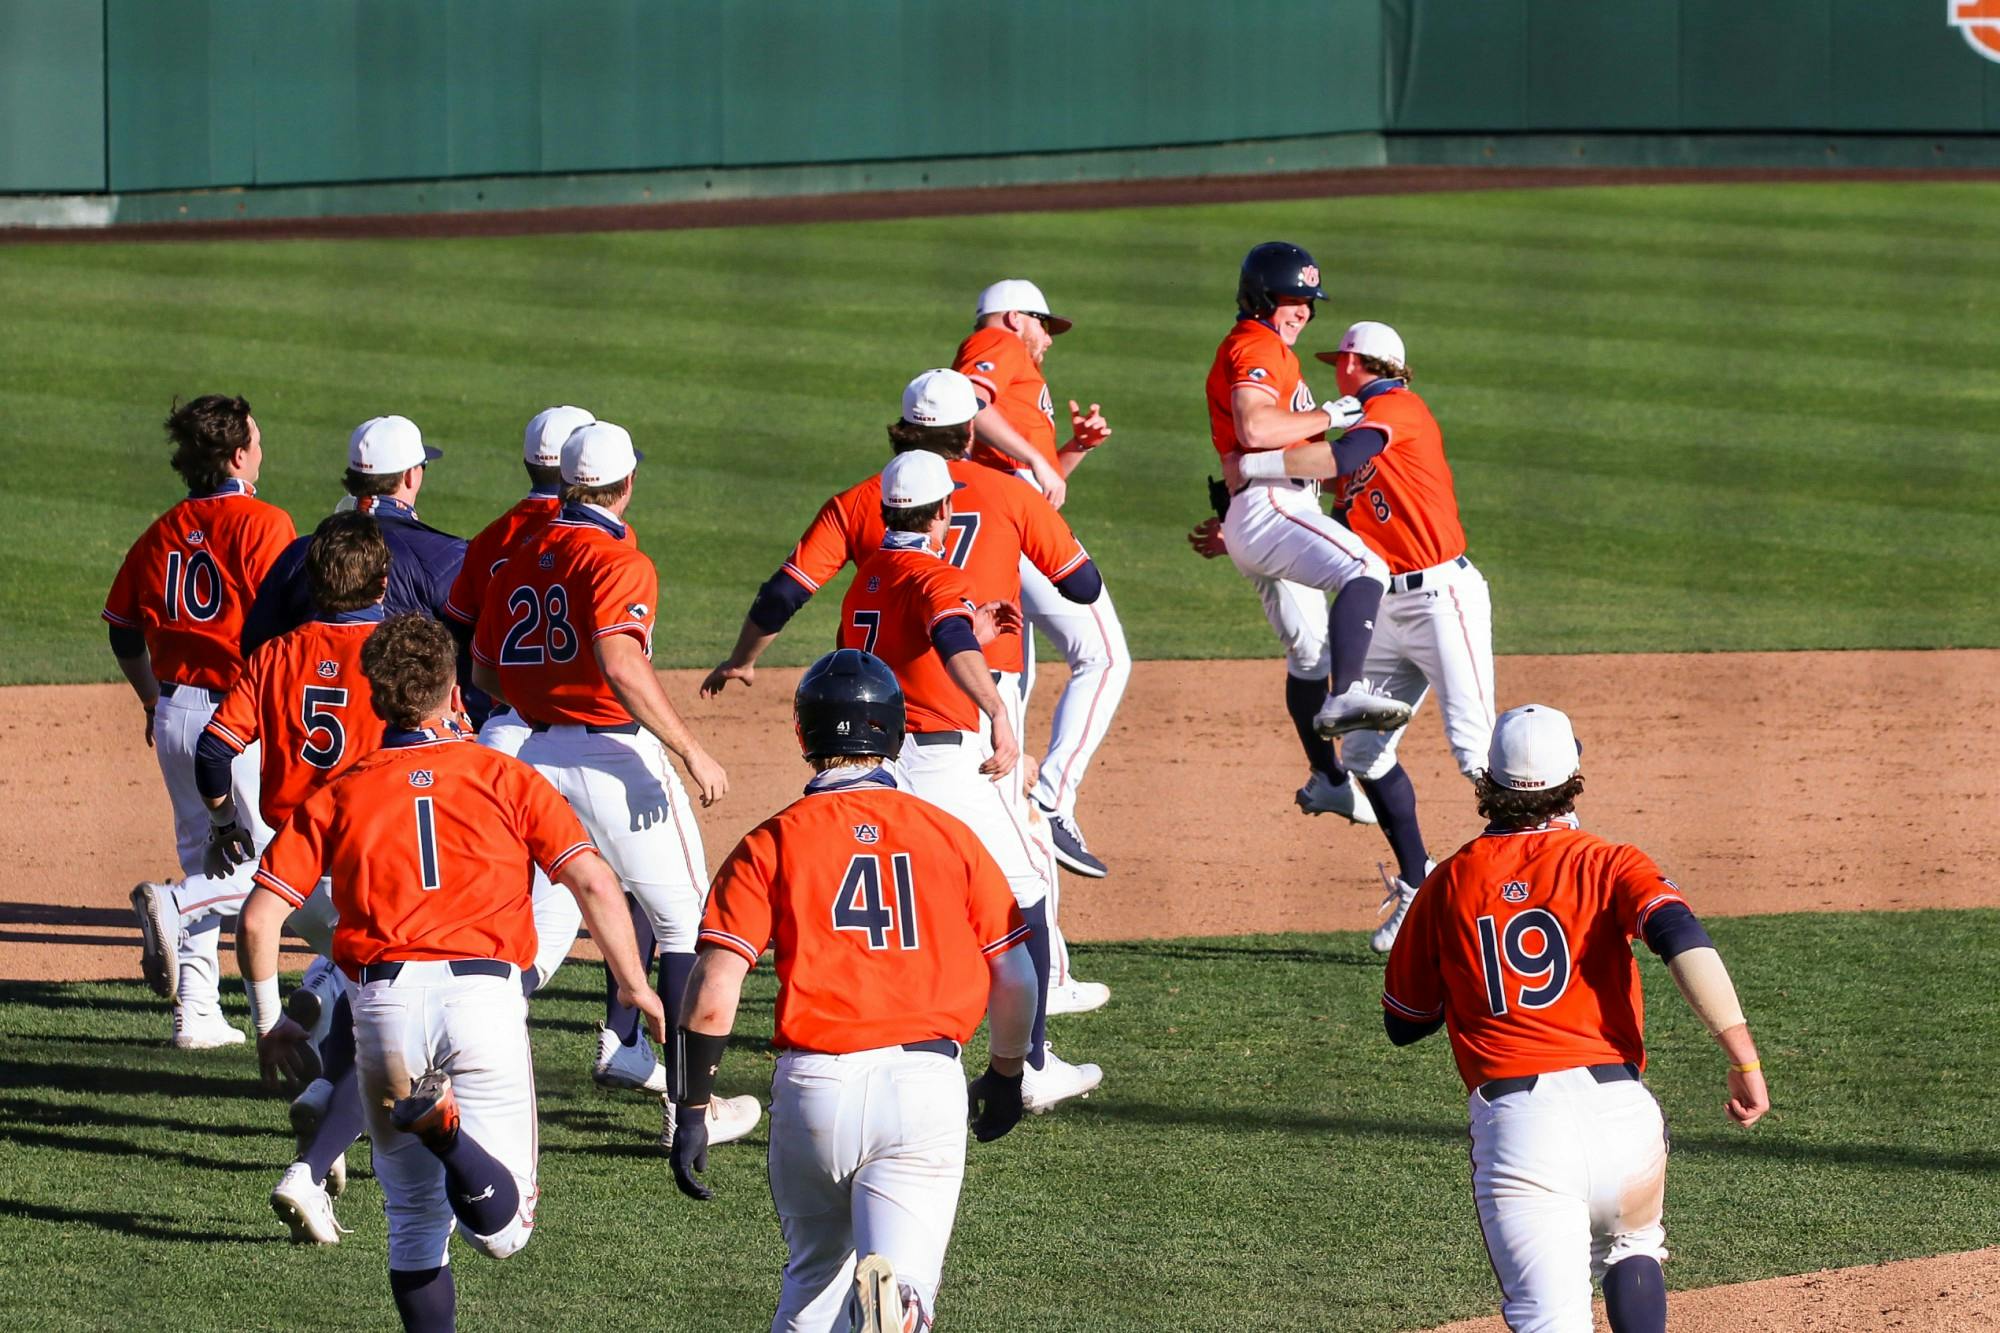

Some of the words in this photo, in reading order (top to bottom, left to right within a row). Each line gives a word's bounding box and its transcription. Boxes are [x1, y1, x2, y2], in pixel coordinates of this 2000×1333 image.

[949, 512, 981, 571] 7
[1370, 489, 1391, 523] 8
[164, 550, 222, 622] 10
[500, 583, 579, 665] 28
[852, 610, 881, 654] 7
[300, 685, 349, 769] 5
[837, 721, 851, 731] 41
[1511, 780, 1546, 788] TIGERS
[412, 795, 441, 891] 1
[832, 852, 920, 951] 41
[1476, 908, 1571, 1018] 19
